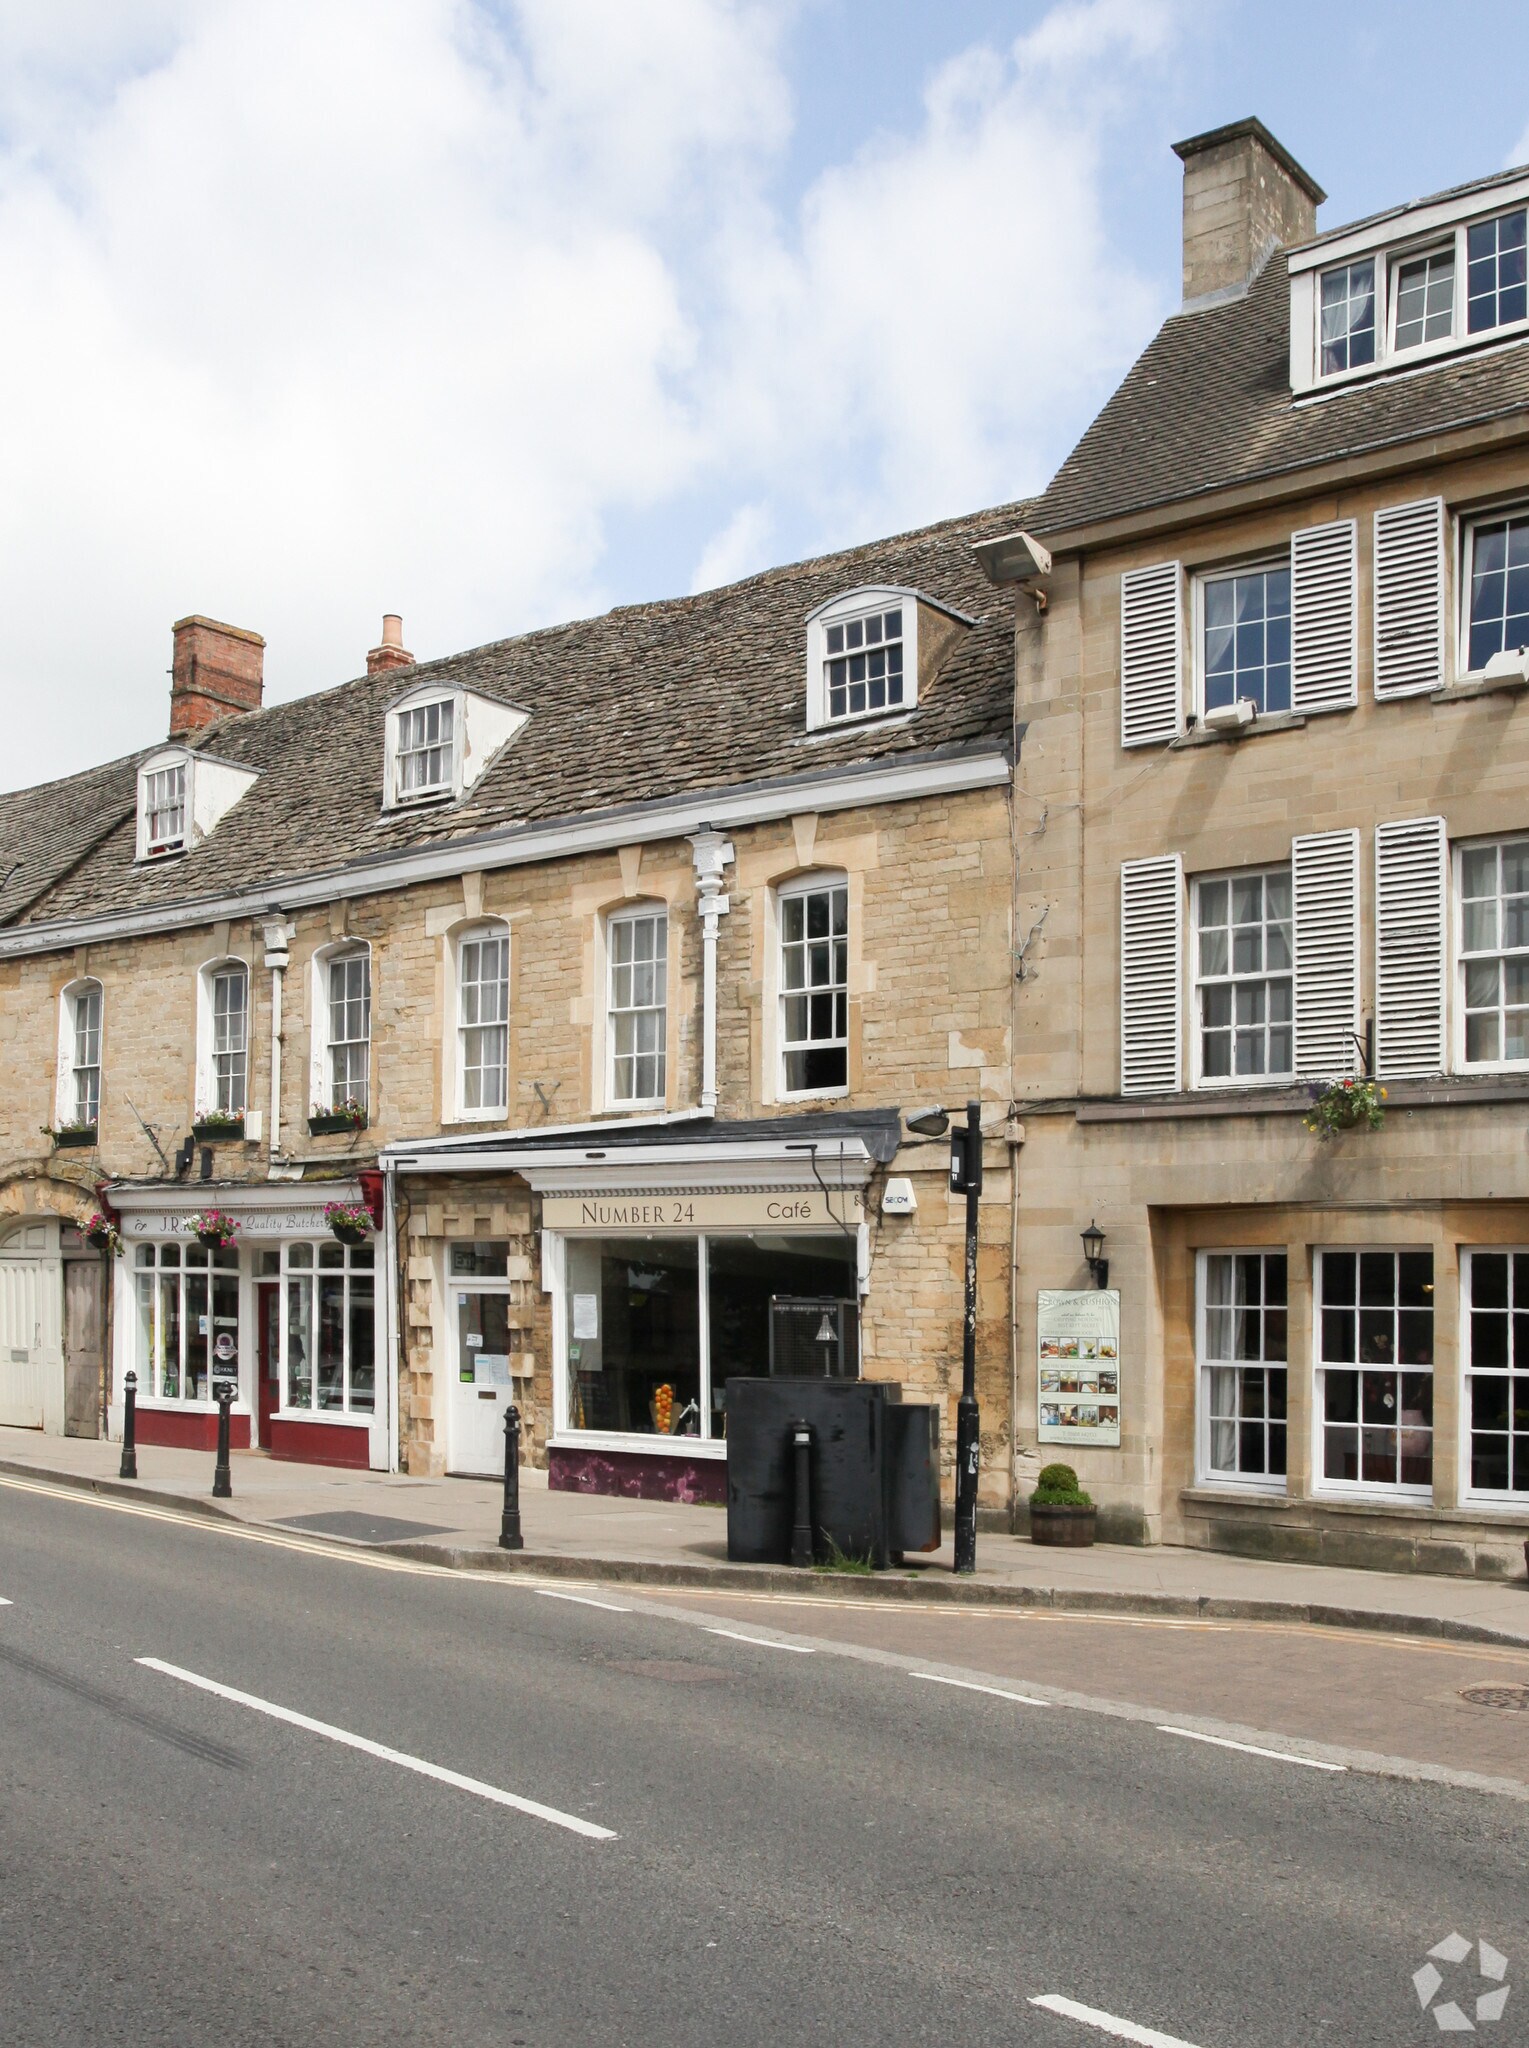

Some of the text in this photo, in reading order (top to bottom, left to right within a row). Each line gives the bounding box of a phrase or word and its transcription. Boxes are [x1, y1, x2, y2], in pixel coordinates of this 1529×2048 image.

[767, 1200, 811, 1219] Café
[885, 1196, 909, 1204] SECOM
[245, 1214, 282, 1232] Quality
[285, 1213, 329, 1229] Butcher
[582, 1202, 695, 1224] NUMBER 24
[1073, 1298, 1080, 1306] &
[1080, 1297, 1117, 1306] CUSHION
